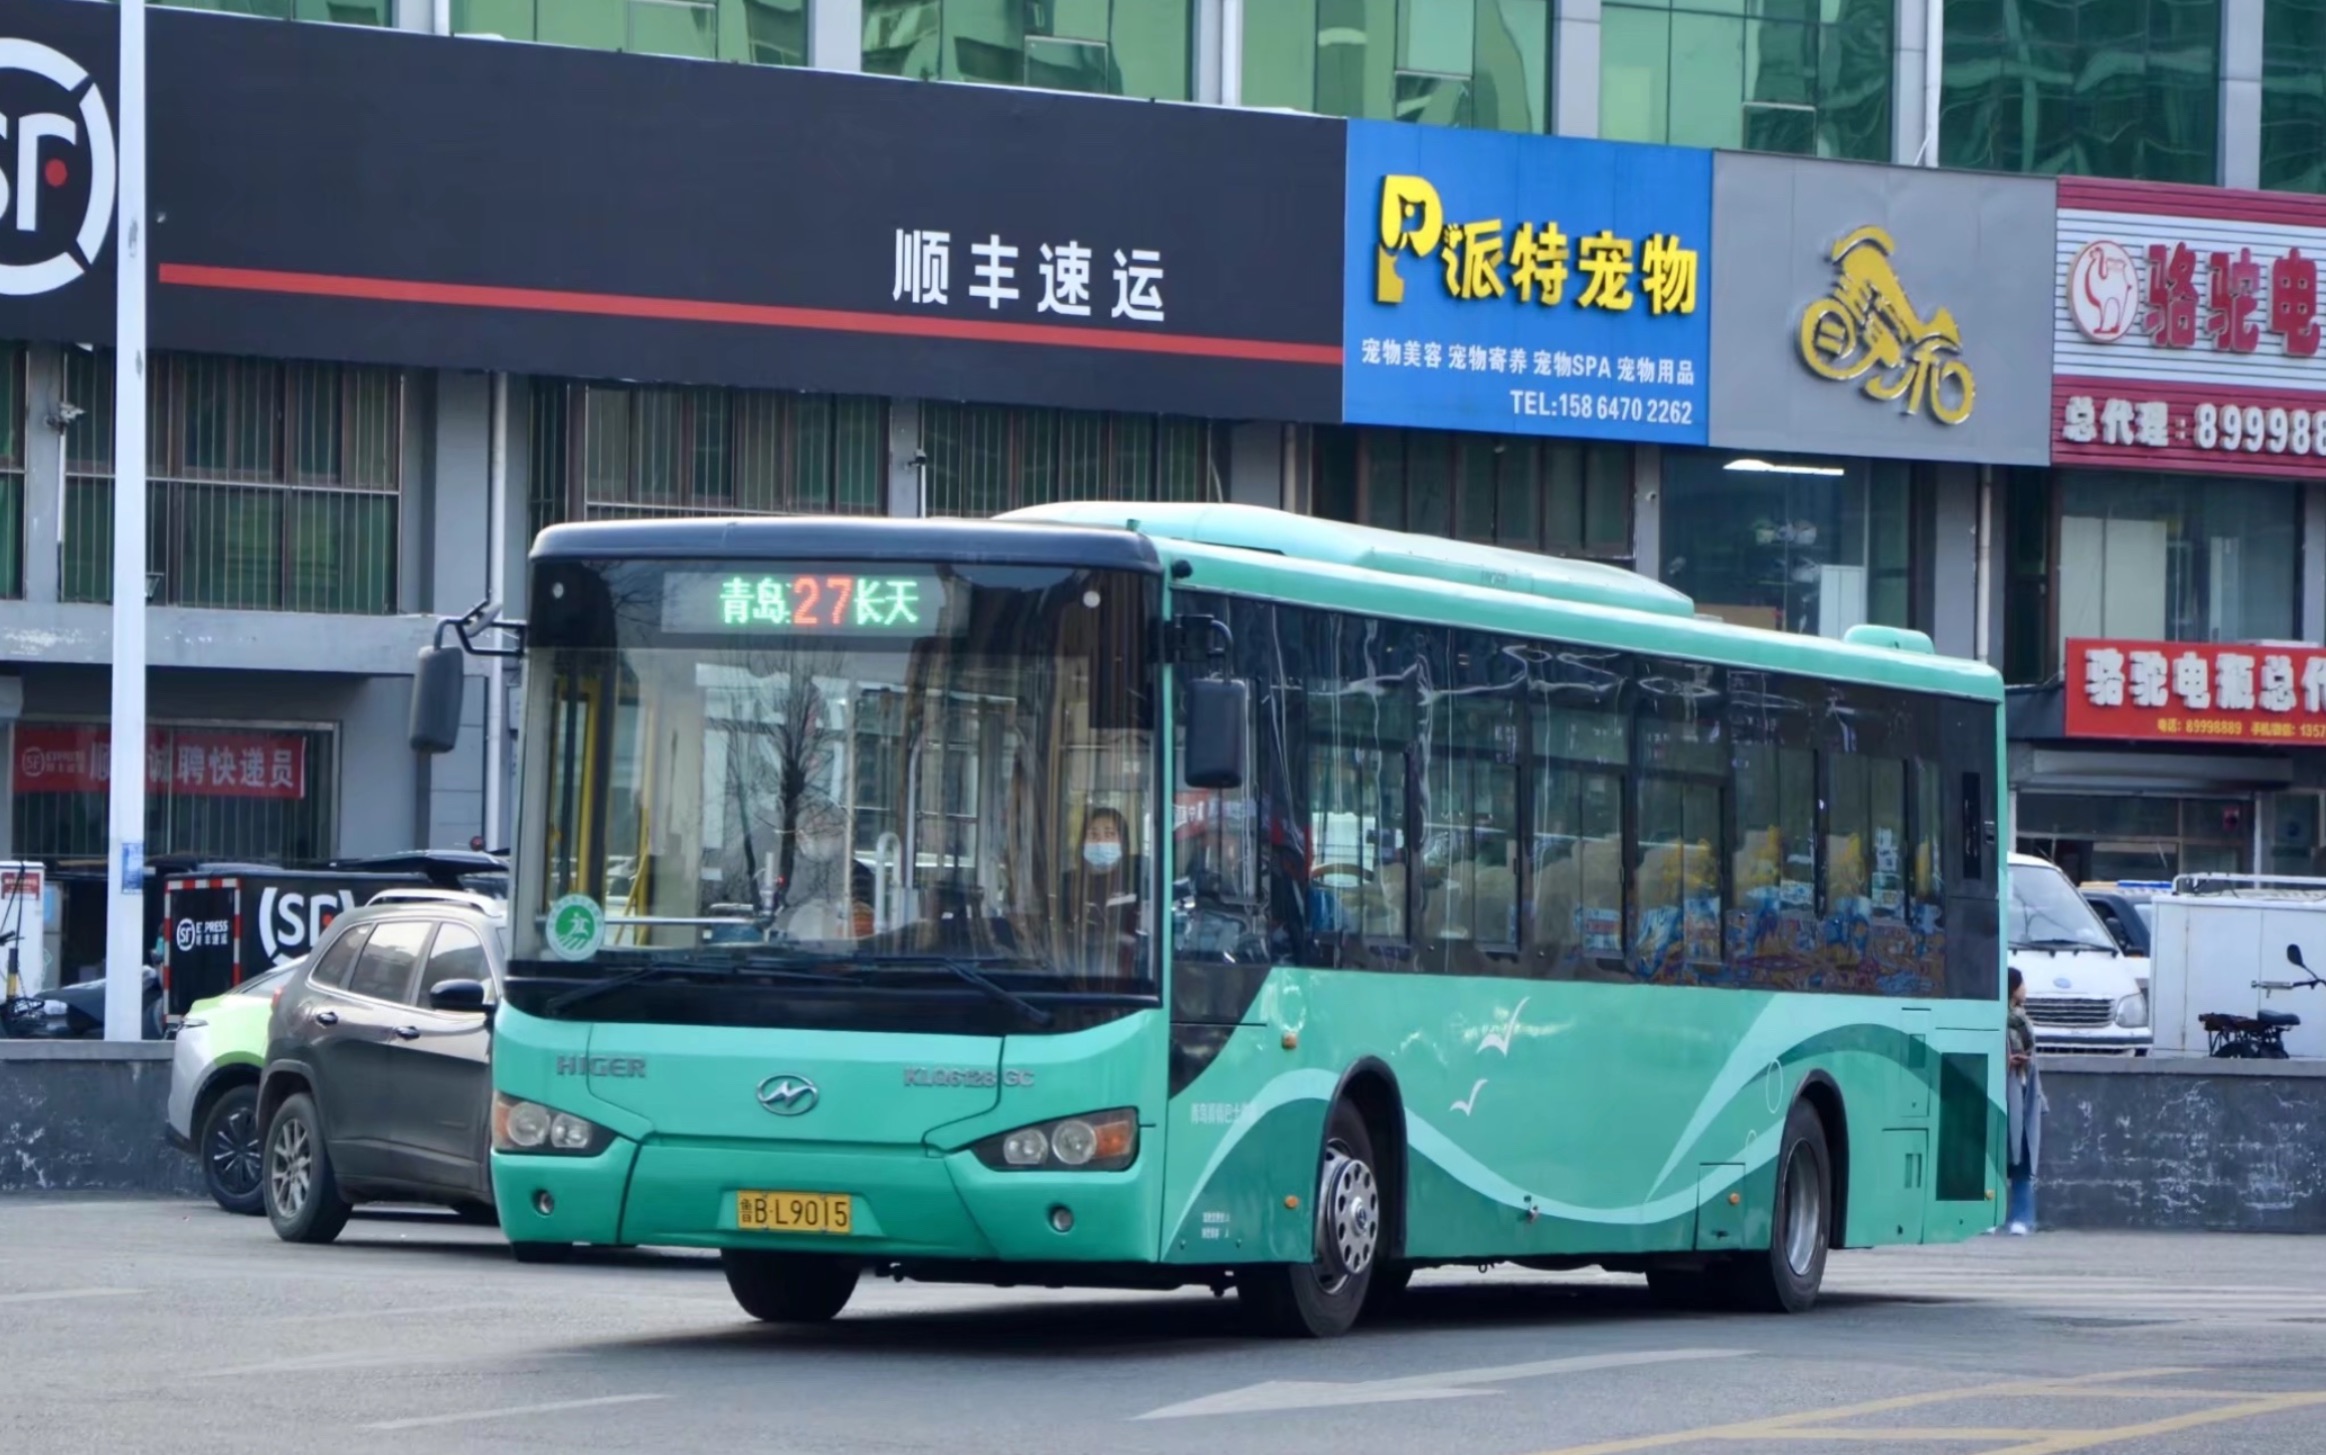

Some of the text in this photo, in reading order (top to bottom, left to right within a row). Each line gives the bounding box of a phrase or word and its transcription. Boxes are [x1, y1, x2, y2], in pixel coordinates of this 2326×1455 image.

[892, 228, 1165, 322] 顺丰速运
[1441, 218, 1698, 315] 派特宠物
[2143, 241, 2320, 356] 骆驼电
[1361, 337, 1695, 386] 宠物美容 宠物寄养 宠物SPA 宠物用品
[1510, 389, 1693, 425] TEL:158 6470 2262
[90, 741, 294, 789] 顺诚聘快递员
[196, 920, 229, 934] EPRESS
[557, 1055, 646, 1078] HIGER
